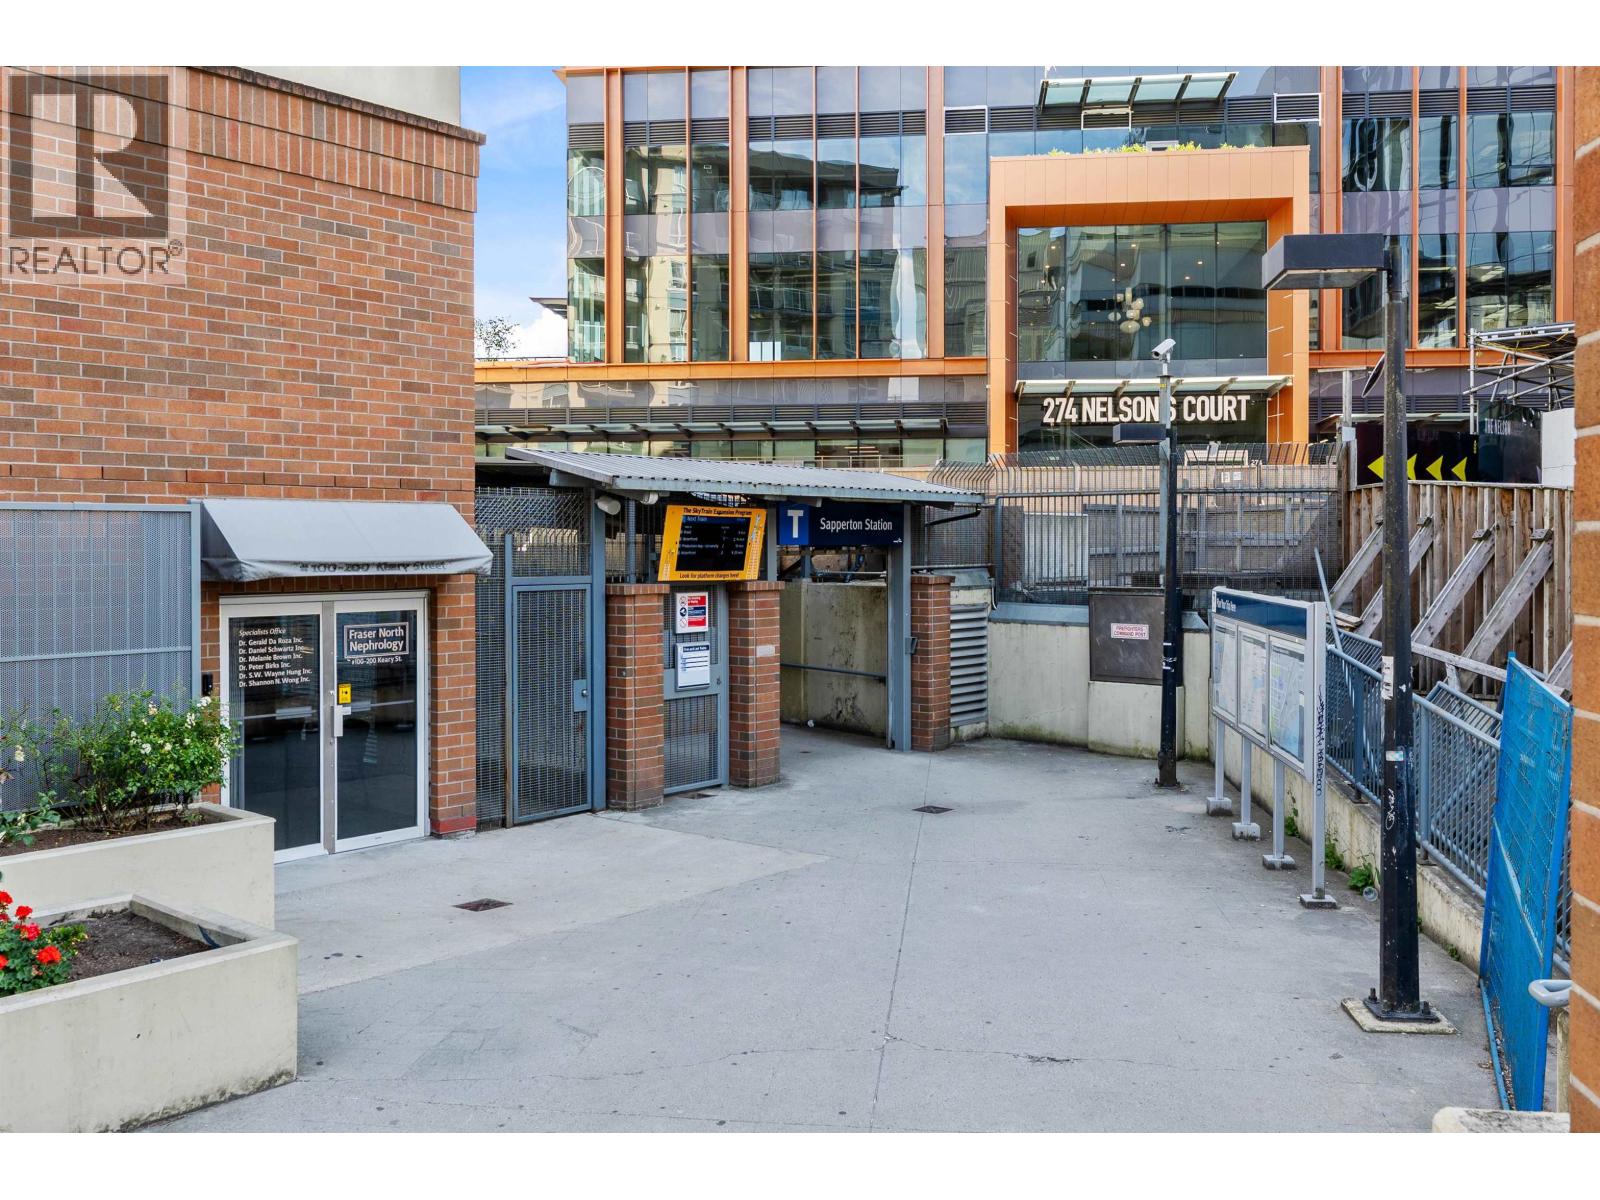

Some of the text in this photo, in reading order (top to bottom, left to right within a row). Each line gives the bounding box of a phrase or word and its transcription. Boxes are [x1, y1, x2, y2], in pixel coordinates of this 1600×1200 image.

[1043, 395, 1250, 423] 274 NELSONS COURT
[787, 509, 804, 538] T
[820, 517, 893, 533] Sapperton Station
[239, 627, 286, 637] Specialists Office
[349, 627, 404, 639] Fraser North
[350, 639, 404, 653] Nephrology
[378, 656, 394, 664] Keary
